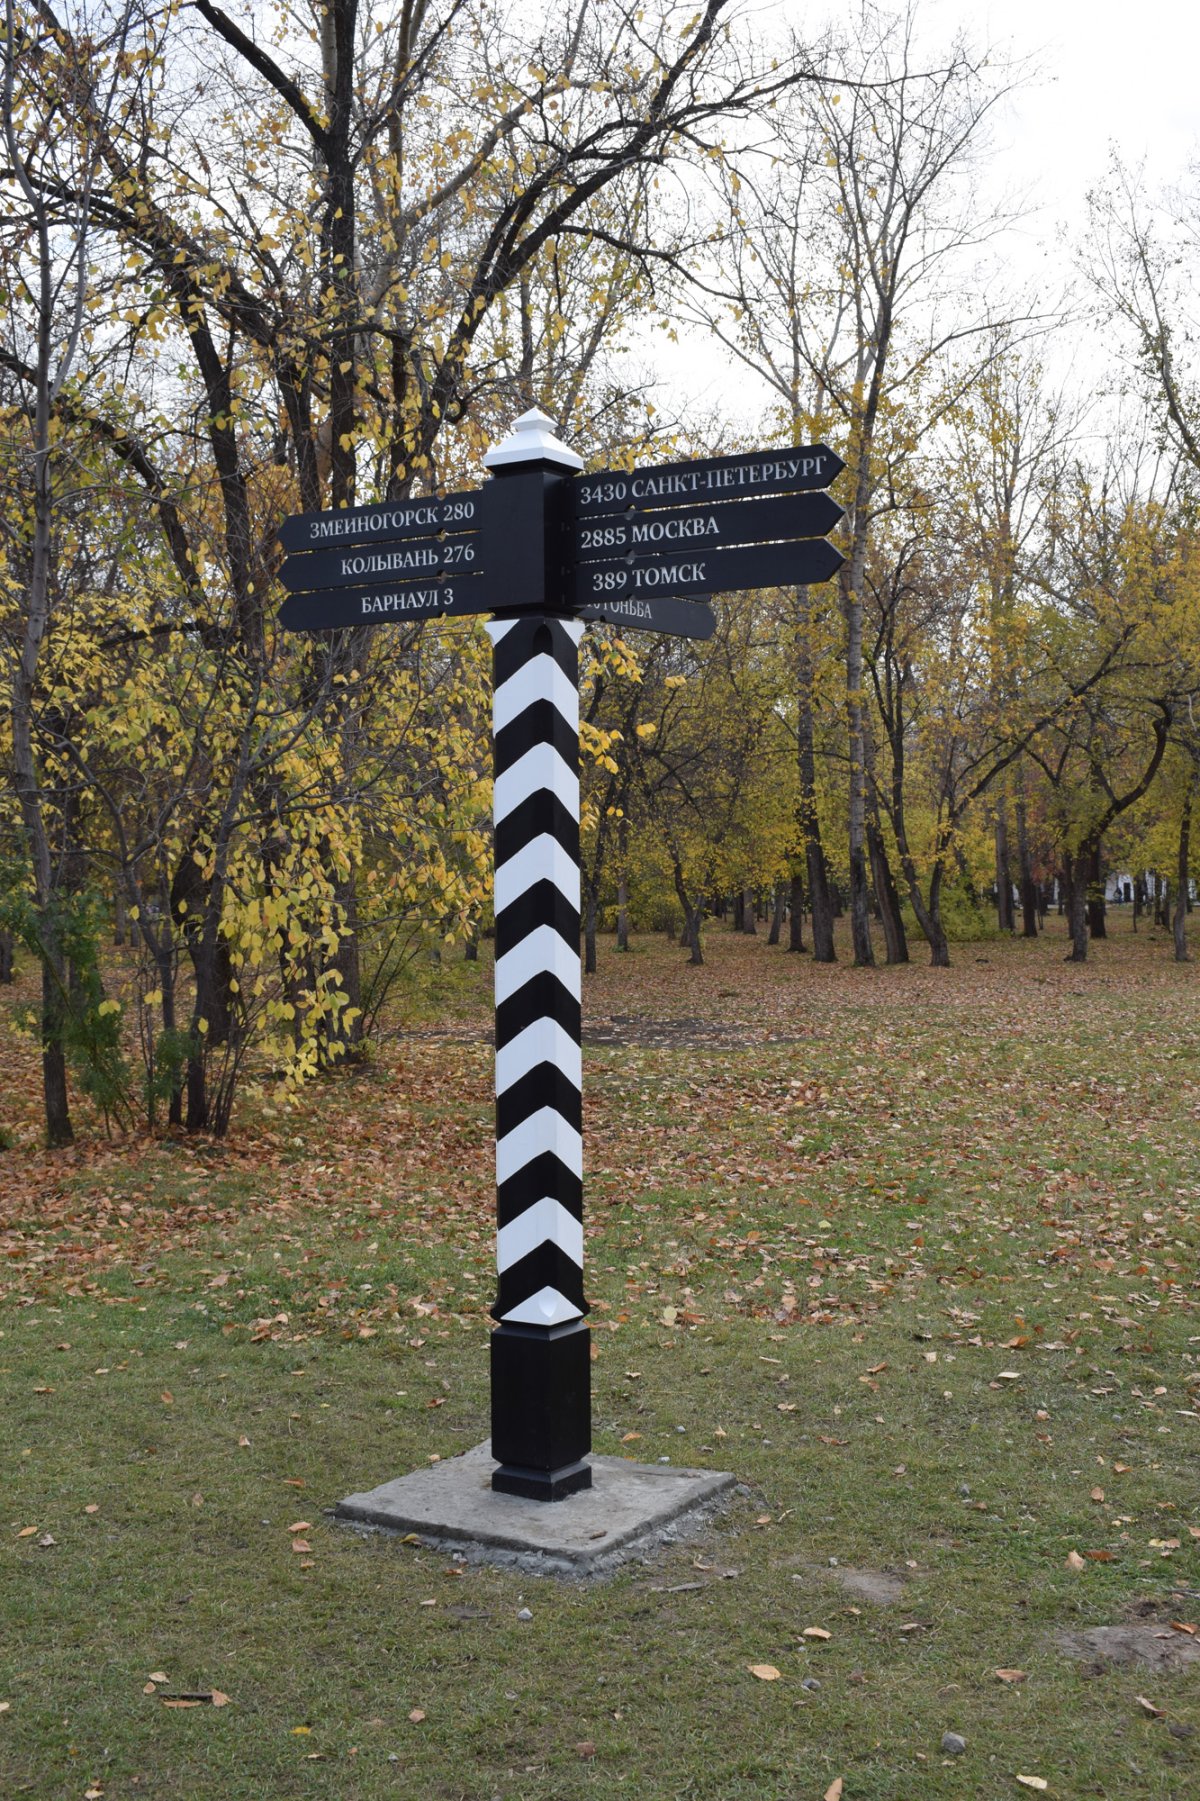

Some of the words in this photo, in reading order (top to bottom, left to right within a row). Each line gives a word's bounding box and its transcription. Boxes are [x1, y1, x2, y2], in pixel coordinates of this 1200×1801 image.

[580, 482, 627, 505] 3430
[631, 455, 827, 498] САНКТ-ПЕТЕРБУРГ
[310, 507, 438, 539] ЗМЕИНОГОРСК
[443, 502, 475, 522] 280
[581, 527, 626, 549] 2885
[631, 516, 720, 543] МОСКВА
[341, 548, 438, 575] КОЛЫВАНЬ
[443, 544, 475, 563] 276
[593, 572, 627, 591] 389
[632, 563, 706, 588] ТОМСК
[361, 590, 438, 614] БАРНАУЛ
